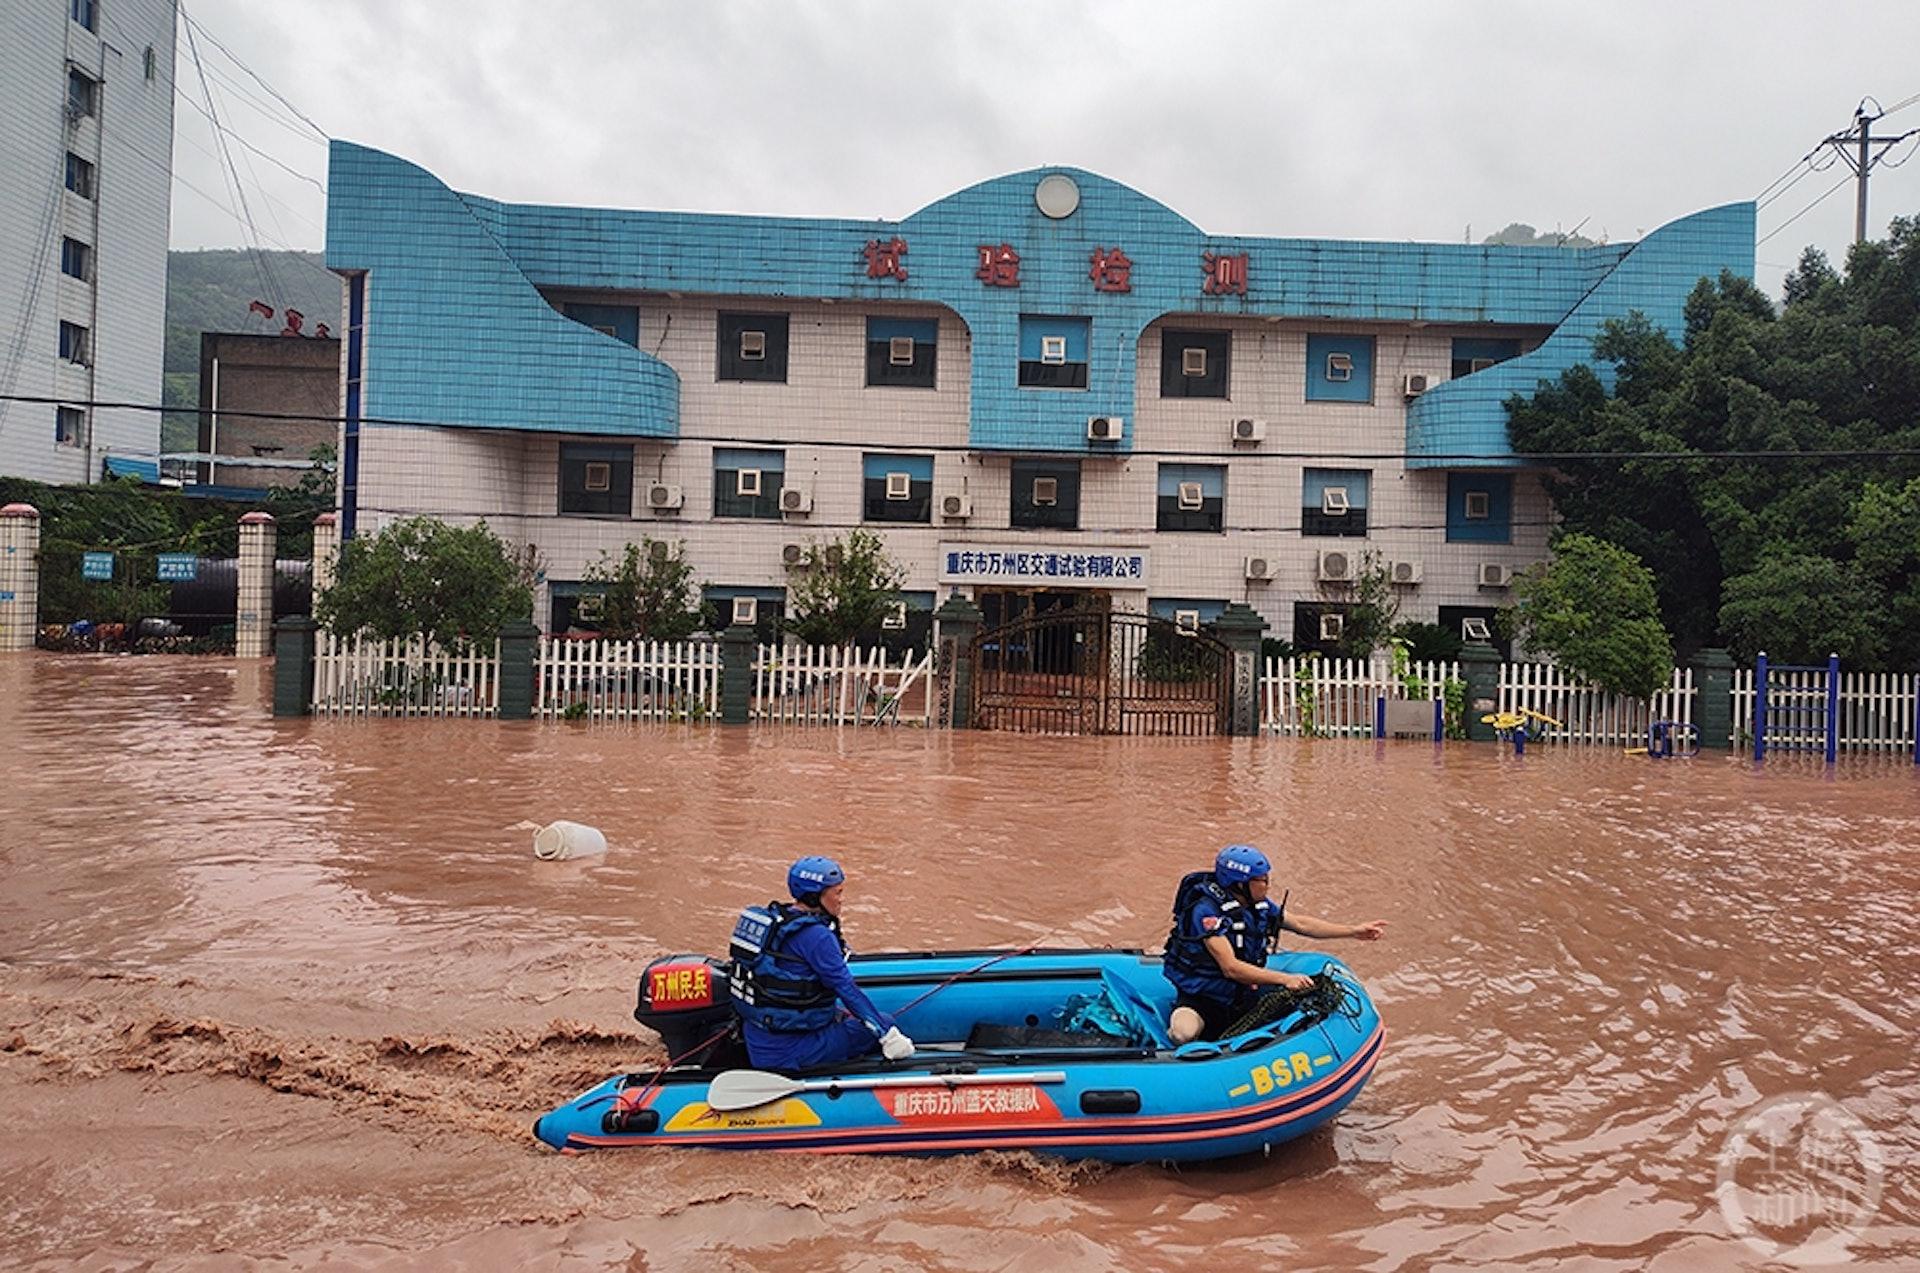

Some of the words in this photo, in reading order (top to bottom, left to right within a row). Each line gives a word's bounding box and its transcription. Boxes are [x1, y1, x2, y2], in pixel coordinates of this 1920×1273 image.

[863, 236, 1249, 296] 试验检测
[946, 551, 1143, 578] 重庆市万州区交通试验有限公司
[653, 968, 708, 1002] 万州民兵
[893, 1086, 1041, 1117] 重庆市万州蓝天救援队
